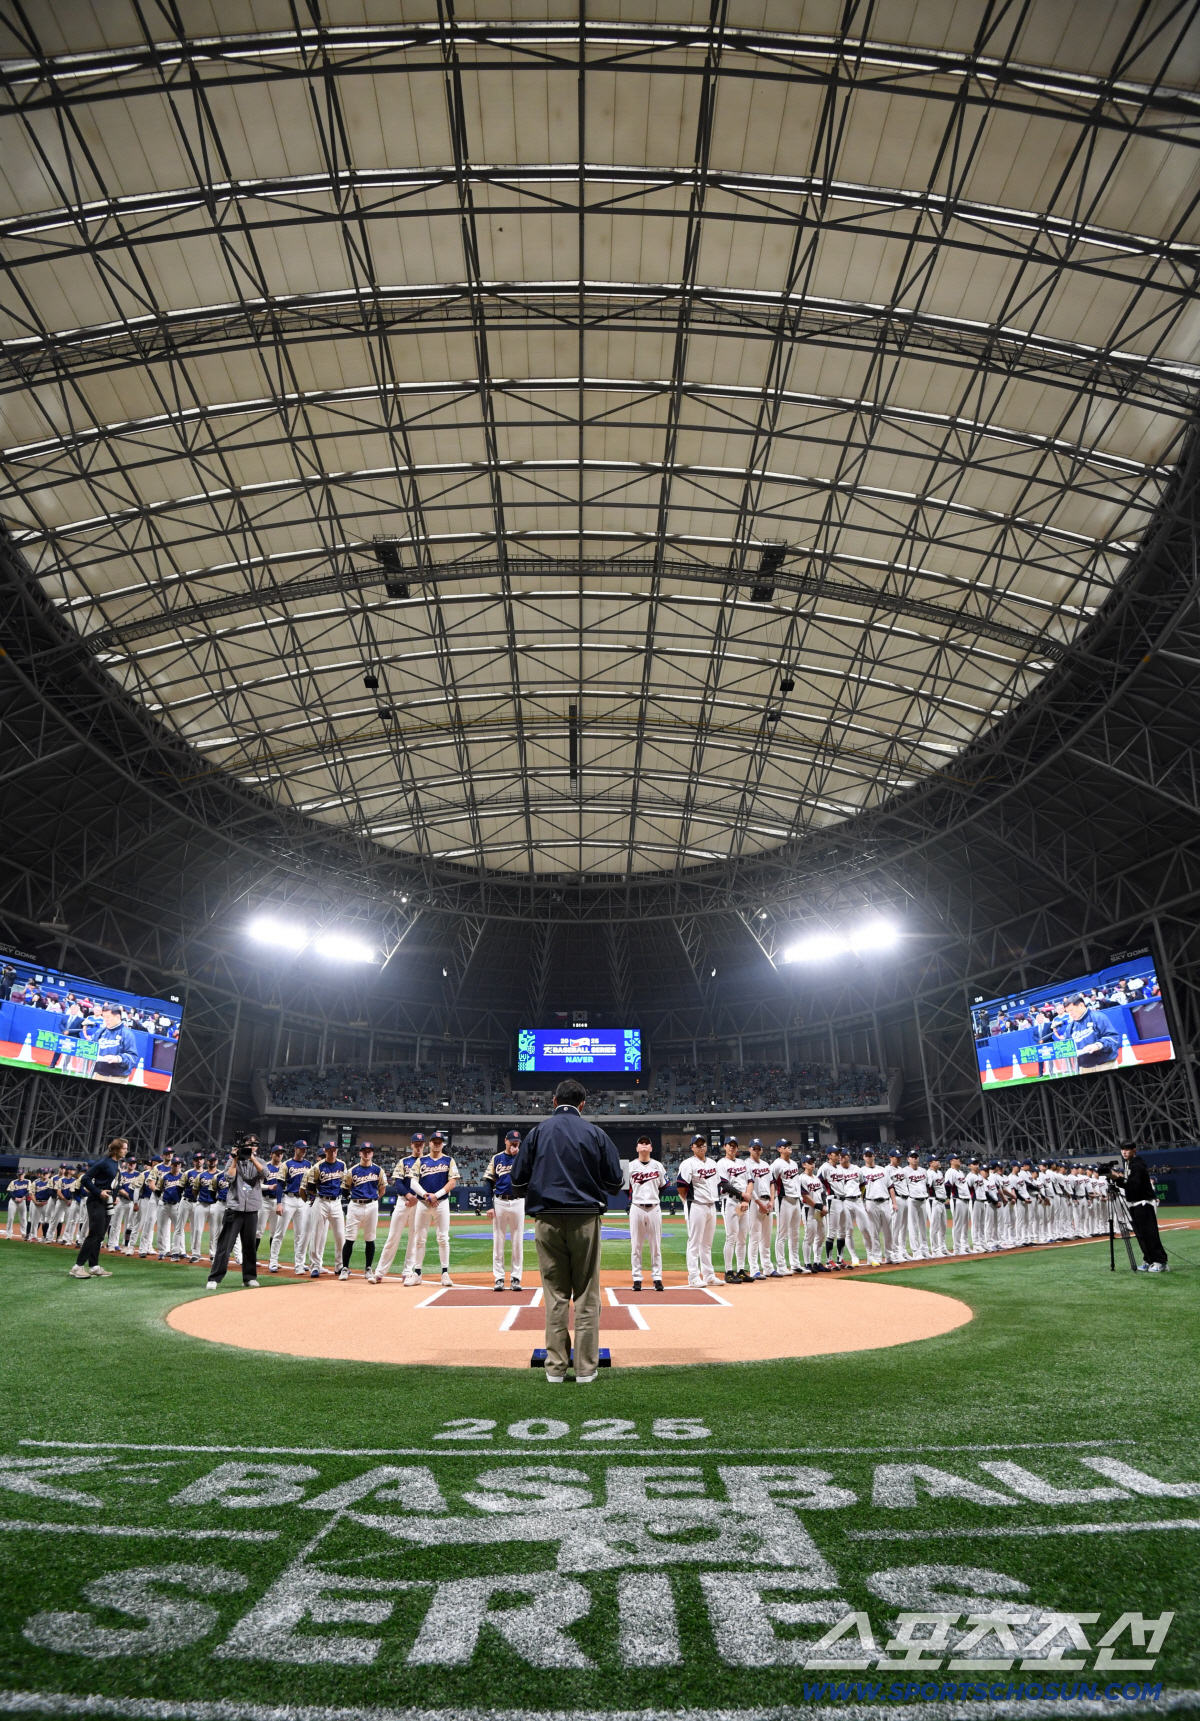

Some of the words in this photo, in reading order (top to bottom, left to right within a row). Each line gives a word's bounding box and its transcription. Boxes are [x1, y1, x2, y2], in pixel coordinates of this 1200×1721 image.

[565, 1056, 594, 1064] NAVER
[631, 1171, 660, 1184] Korea
[433, 1418, 713, 1441] 2025
[22, 1563, 1077, 1670] SERIES
